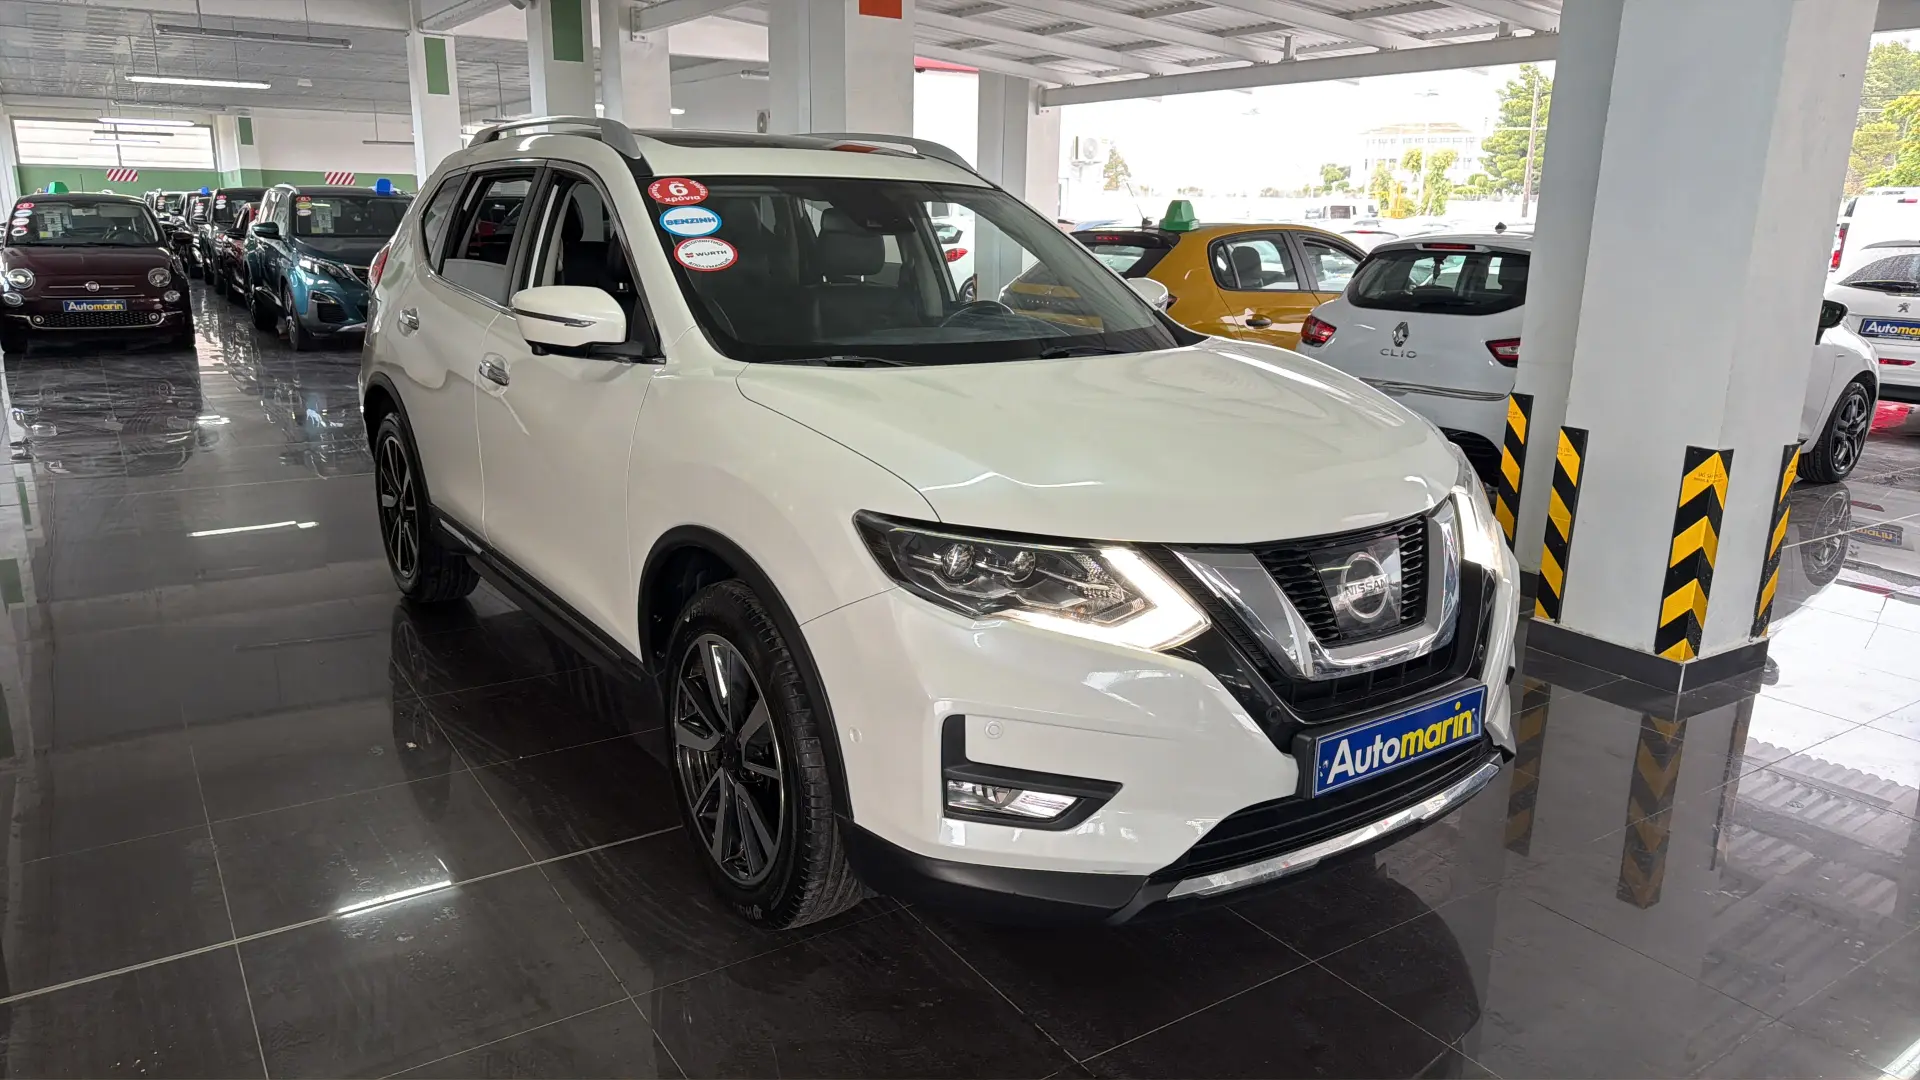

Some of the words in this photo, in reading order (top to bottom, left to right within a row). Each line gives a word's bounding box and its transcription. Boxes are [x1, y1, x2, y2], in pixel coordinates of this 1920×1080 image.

[668, 182, 689, 197] 6
[664, 195, 701, 203] χρόνια
[68, 301, 123, 311] Automarin
[1380, 348, 1418, 359] CLIO
[1345, 578, 1386, 598] NISSAN
[1326, 701, 1473, 785] Automarin
